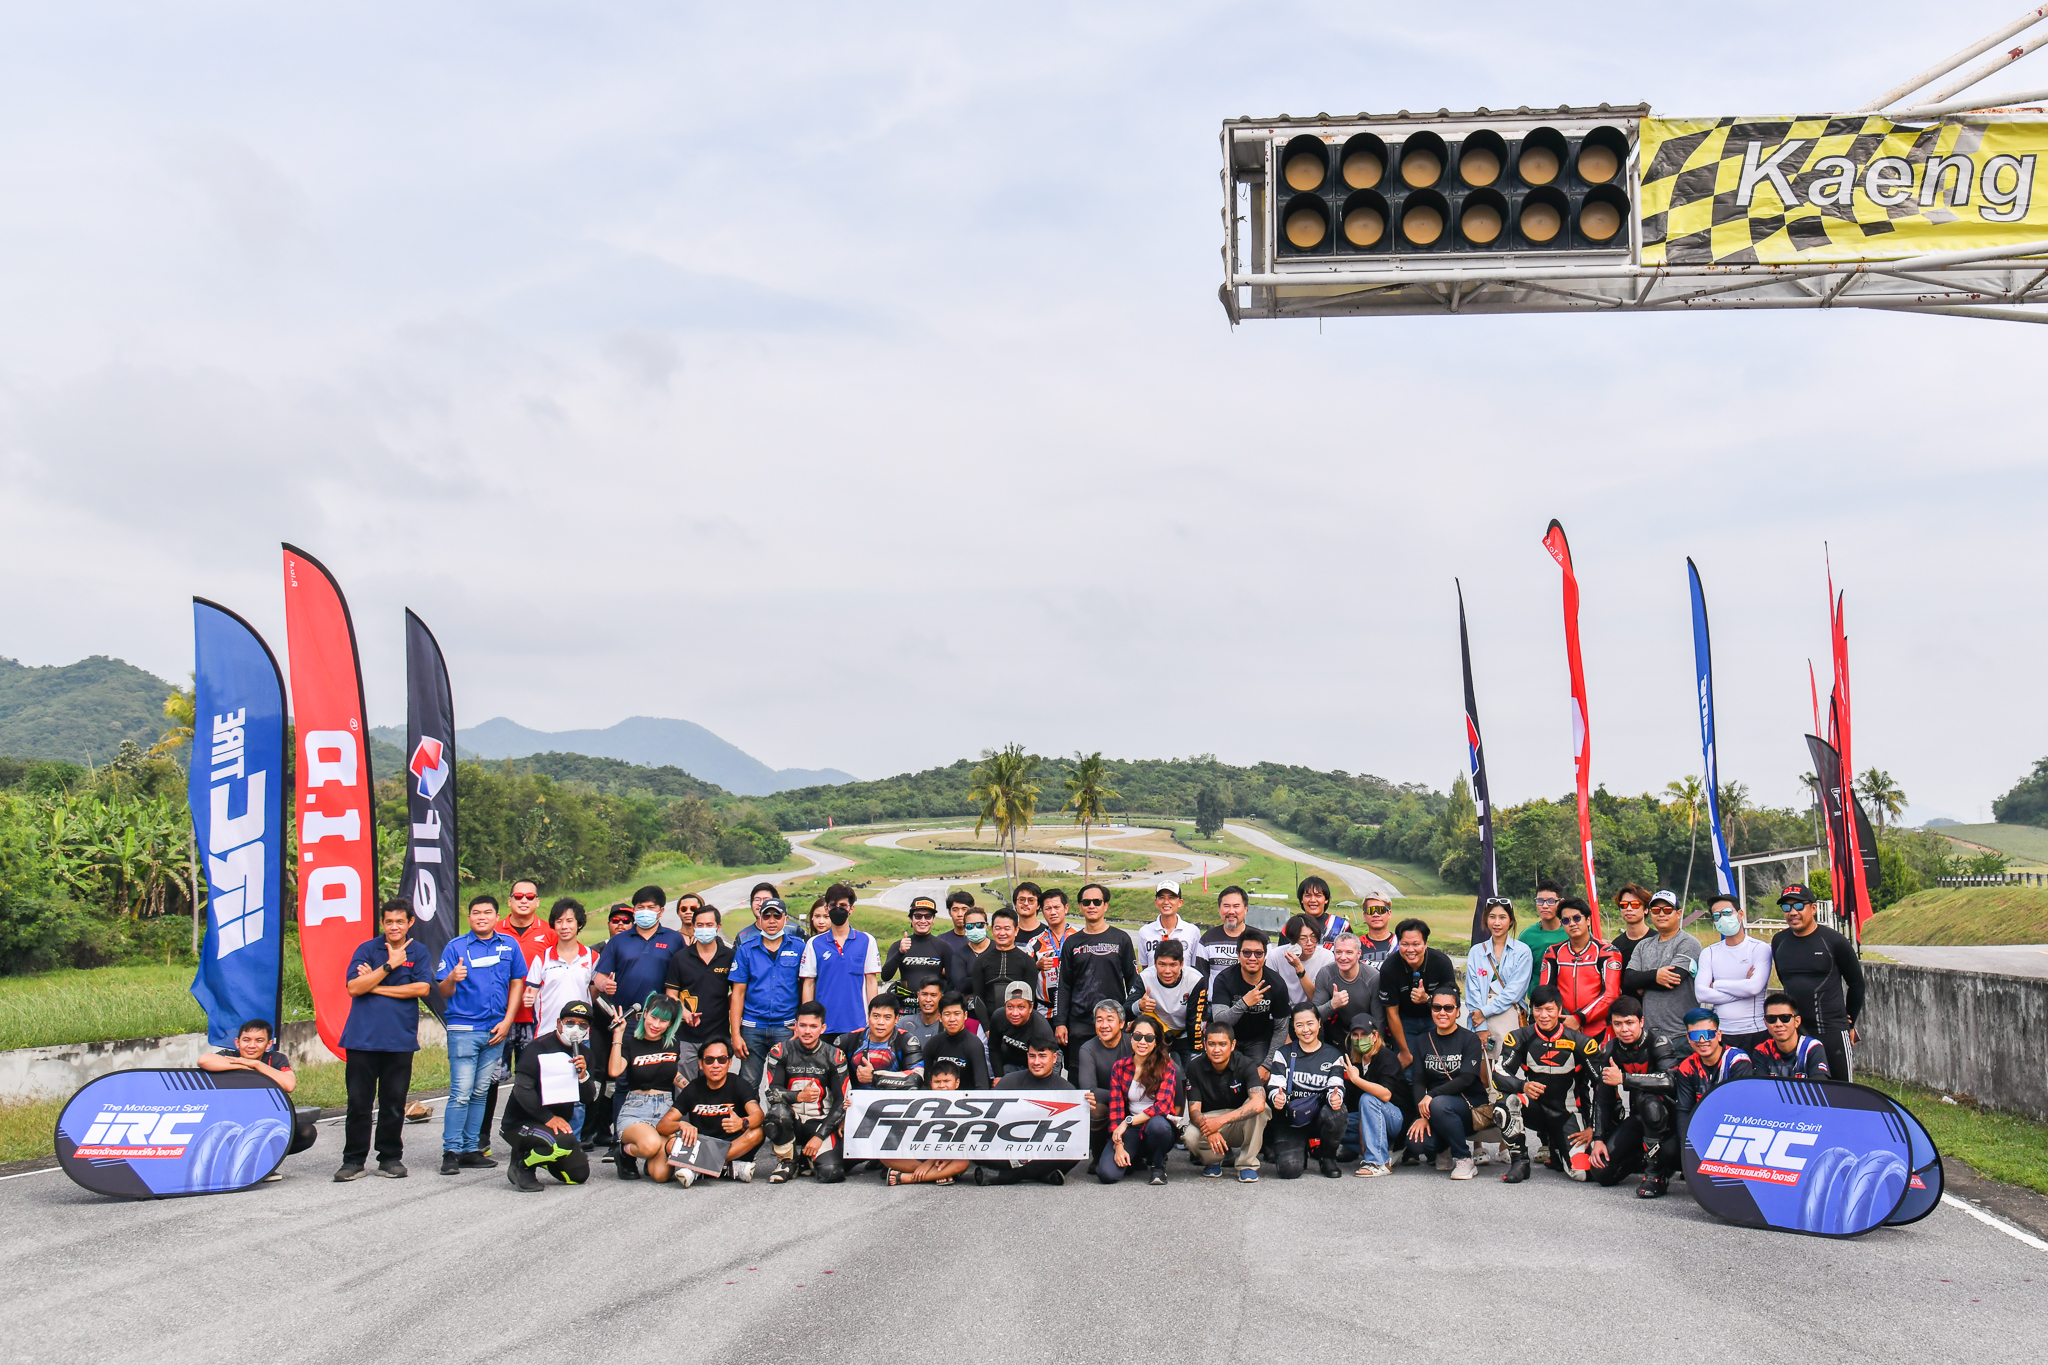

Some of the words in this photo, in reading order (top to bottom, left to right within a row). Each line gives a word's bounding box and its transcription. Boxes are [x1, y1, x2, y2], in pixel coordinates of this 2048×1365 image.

[1735, 140, 2038, 222] Kaeng
[102, 1103, 122, 1111] The
[123, 1103, 181, 1113] Motosport
[182, 1103, 209, 1112] Spirit
[853, 1098, 1019, 1138] FAST
[878, 1119, 1081, 1151] TRACK
[1723, 1114, 1741, 1124] The
[1742, 1116, 1795, 1130] Motosport
[1796, 1121, 1823, 1133] Spirit
[909, 1143, 990, 1152] WEEKEND
[1005, 1143, 1066, 1152] RIDING
